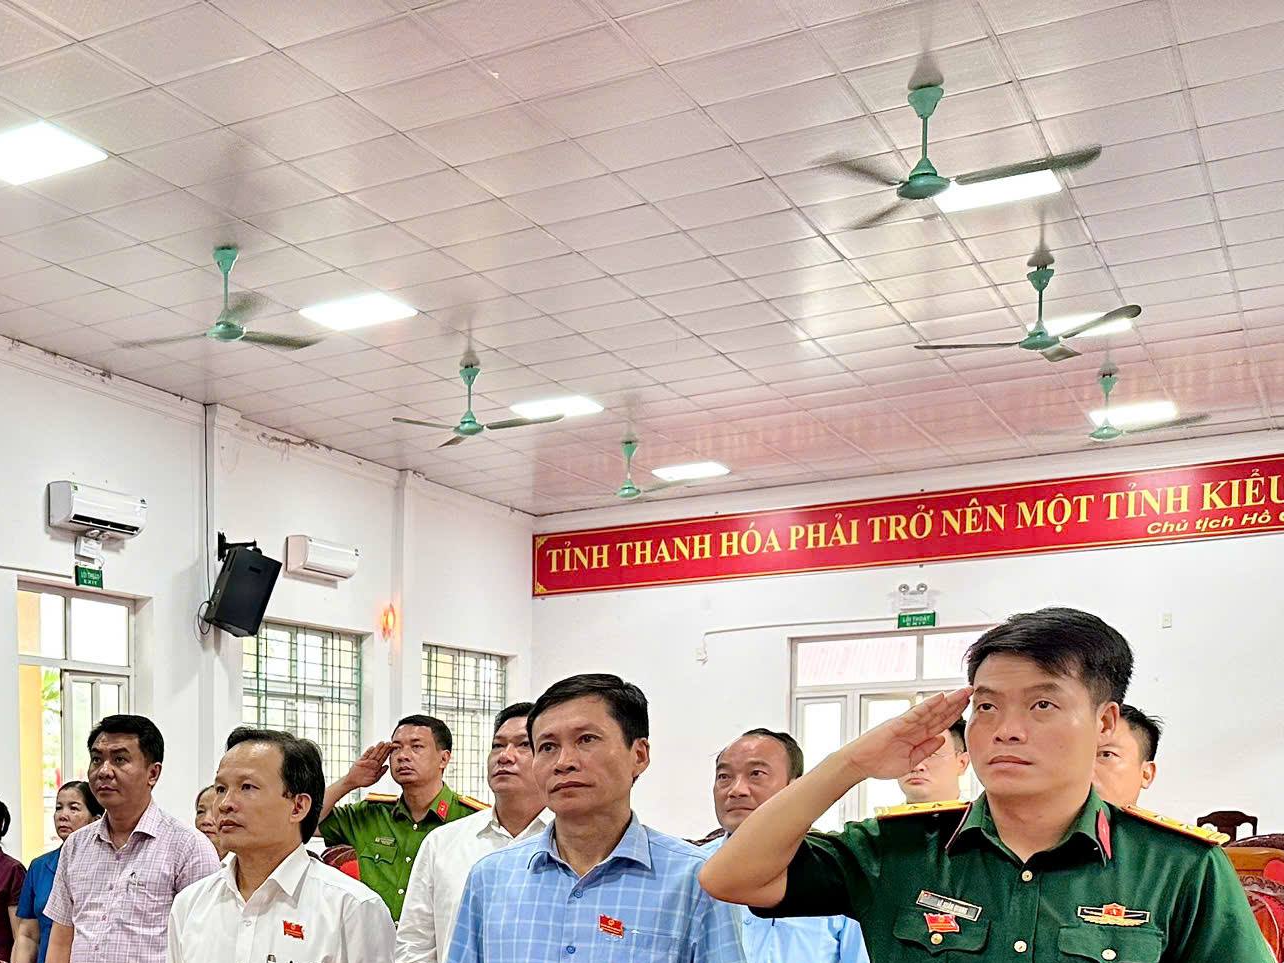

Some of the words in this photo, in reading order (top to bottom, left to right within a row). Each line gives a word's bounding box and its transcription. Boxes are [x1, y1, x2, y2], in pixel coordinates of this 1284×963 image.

[546, 541, 610, 573] TỈNH
[615, 534, 712, 566] THANH
[719, 521, 782, 557] HÓA
[788, 513, 859, 550] PHẢI
[867, 505, 935, 545] TRỞ
[940, 498, 1007, 537] NÊN
[1016, 493, 1095, 533] MỘT
[1102, 482, 1191, 520] TỈNH
[1147, 519, 1188, 535] Chủ
[1196, 515, 1234, 533] tịch
[1241, 509, 1272, 526] Hồ
